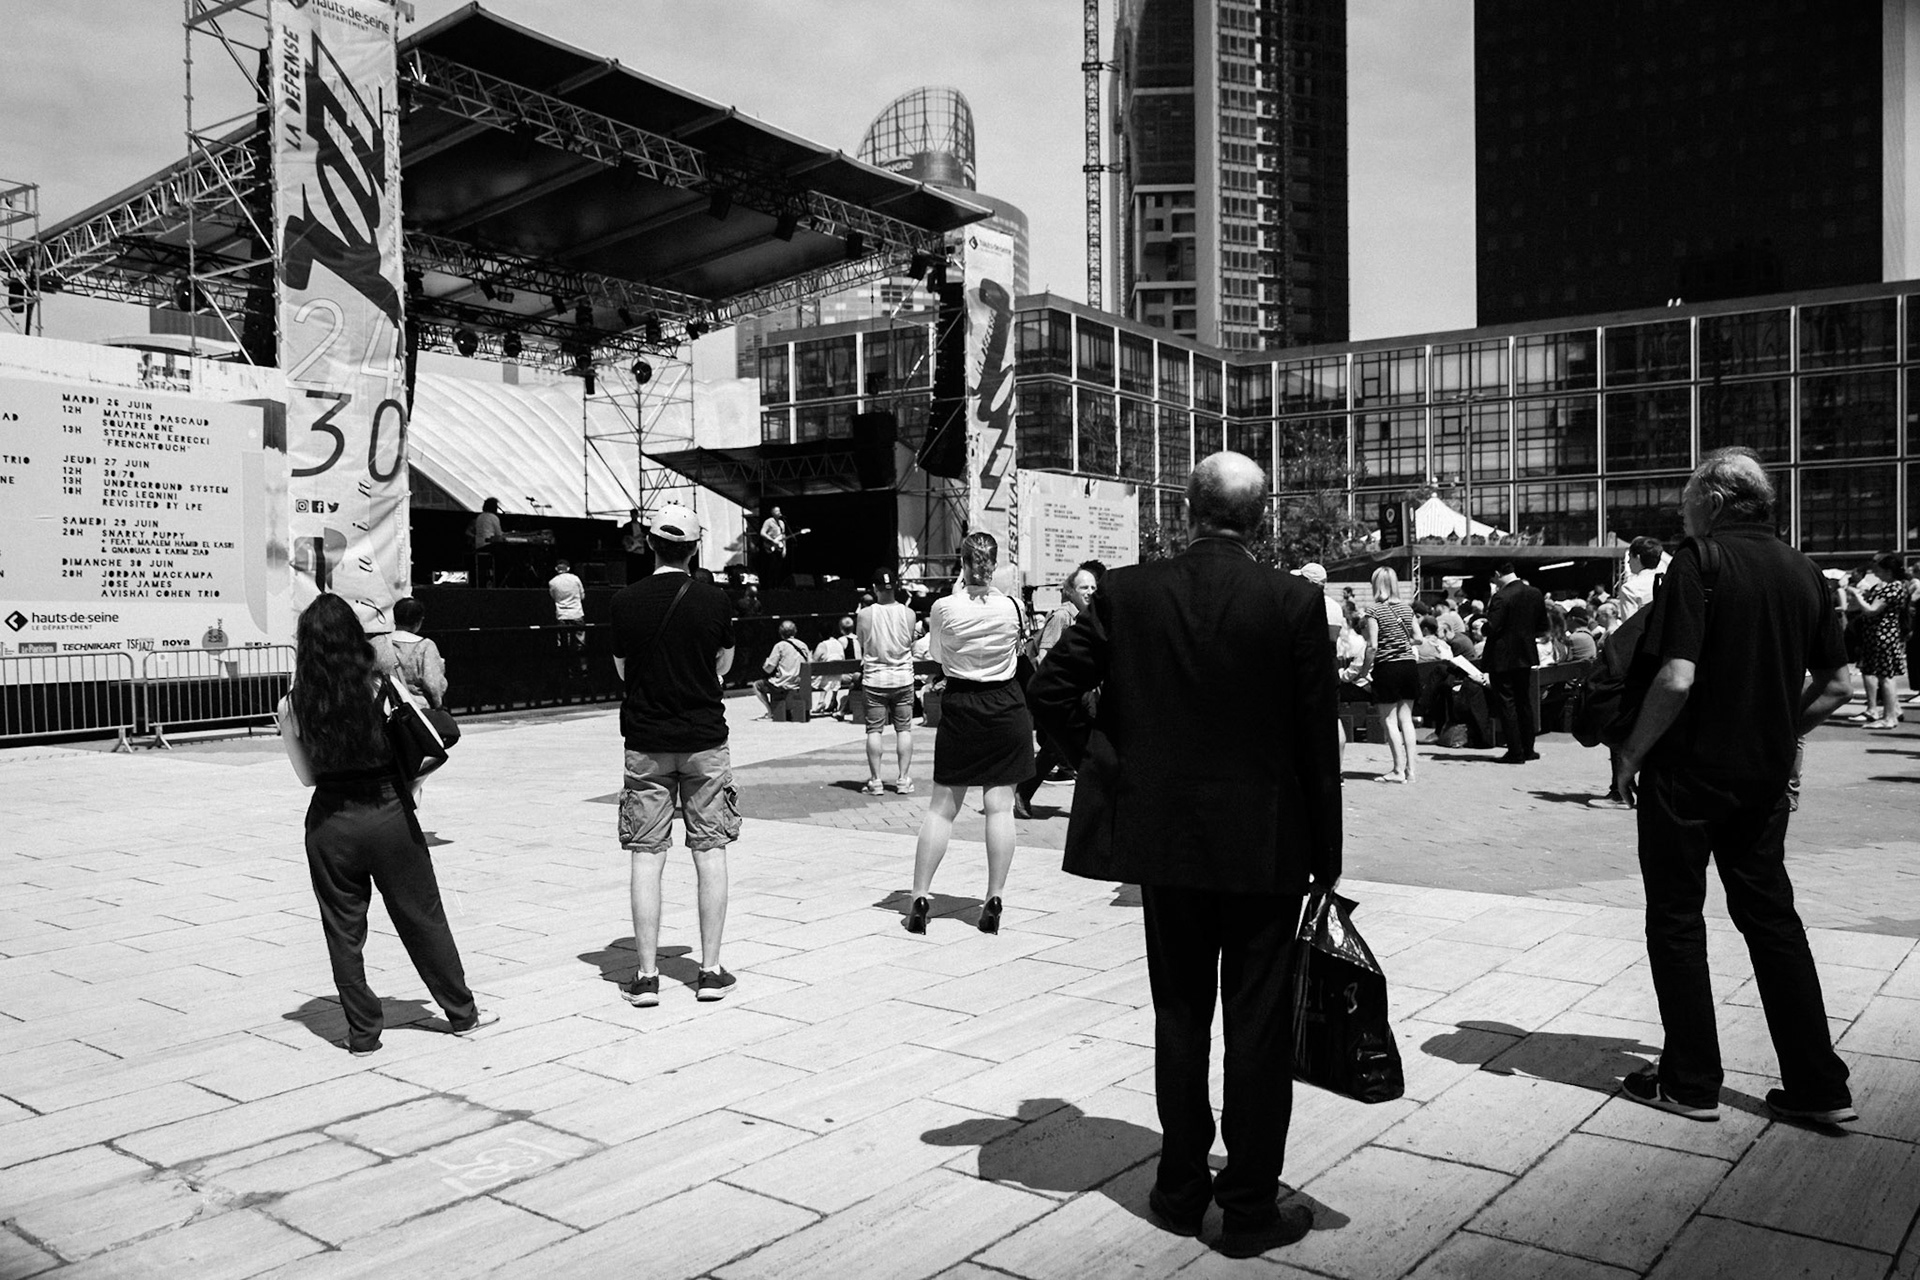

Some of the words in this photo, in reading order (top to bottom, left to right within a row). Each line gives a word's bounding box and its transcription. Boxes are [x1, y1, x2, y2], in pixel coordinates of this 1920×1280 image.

[284, 123, 301, 151] LA
[62, 394, 99, 404] MARDI
[128, 401, 152, 410] JUIN
[3, 413, 19, 421] AD
[63, 405, 81, 414] 12H
[104, 410, 152, 421] MATTHIS
[160, 415, 209, 426] PASCAUD
[102, 419, 145, 430] SQUARE
[154, 424, 173, 432] ONE
[63, 425, 81, 434] 13H
[104, 429, 159, 440] STEPHANE
[168, 435, 209, 445] KERECKI
[291, 390, 406, 483] 30
[3, 455, 30, 464] TRIO
[63, 455, 96, 464] JEUDI
[105, 458, 117, 466] 27
[125, 460, 149, 468] JUIN
[63, 467, 81, 475] 12H
[104, 469, 134, 478] 30/70
[104, 479, 182, 491] UNDERGROUND
[190, 485, 228, 493] SYSTEM
[63, 487, 81, 495] 18H
[104, 489, 128, 497] ERIC
[136, 491, 177, 499] LEGNINI
[102, 499, 158, 508] REVISITED
[63, 517, 106, 526] SAMEDI
[135, 520, 158, 528] JUIN
[63, 528, 83, 536] 20H
[102, 530, 145, 538] SNARKY
[62, 558, 122, 567] DIMANCHE
[153, 571, 213, 579] MACKAMPA
[62, 642, 122, 651] TECHNIKART
[162, 639, 190, 647] nova
